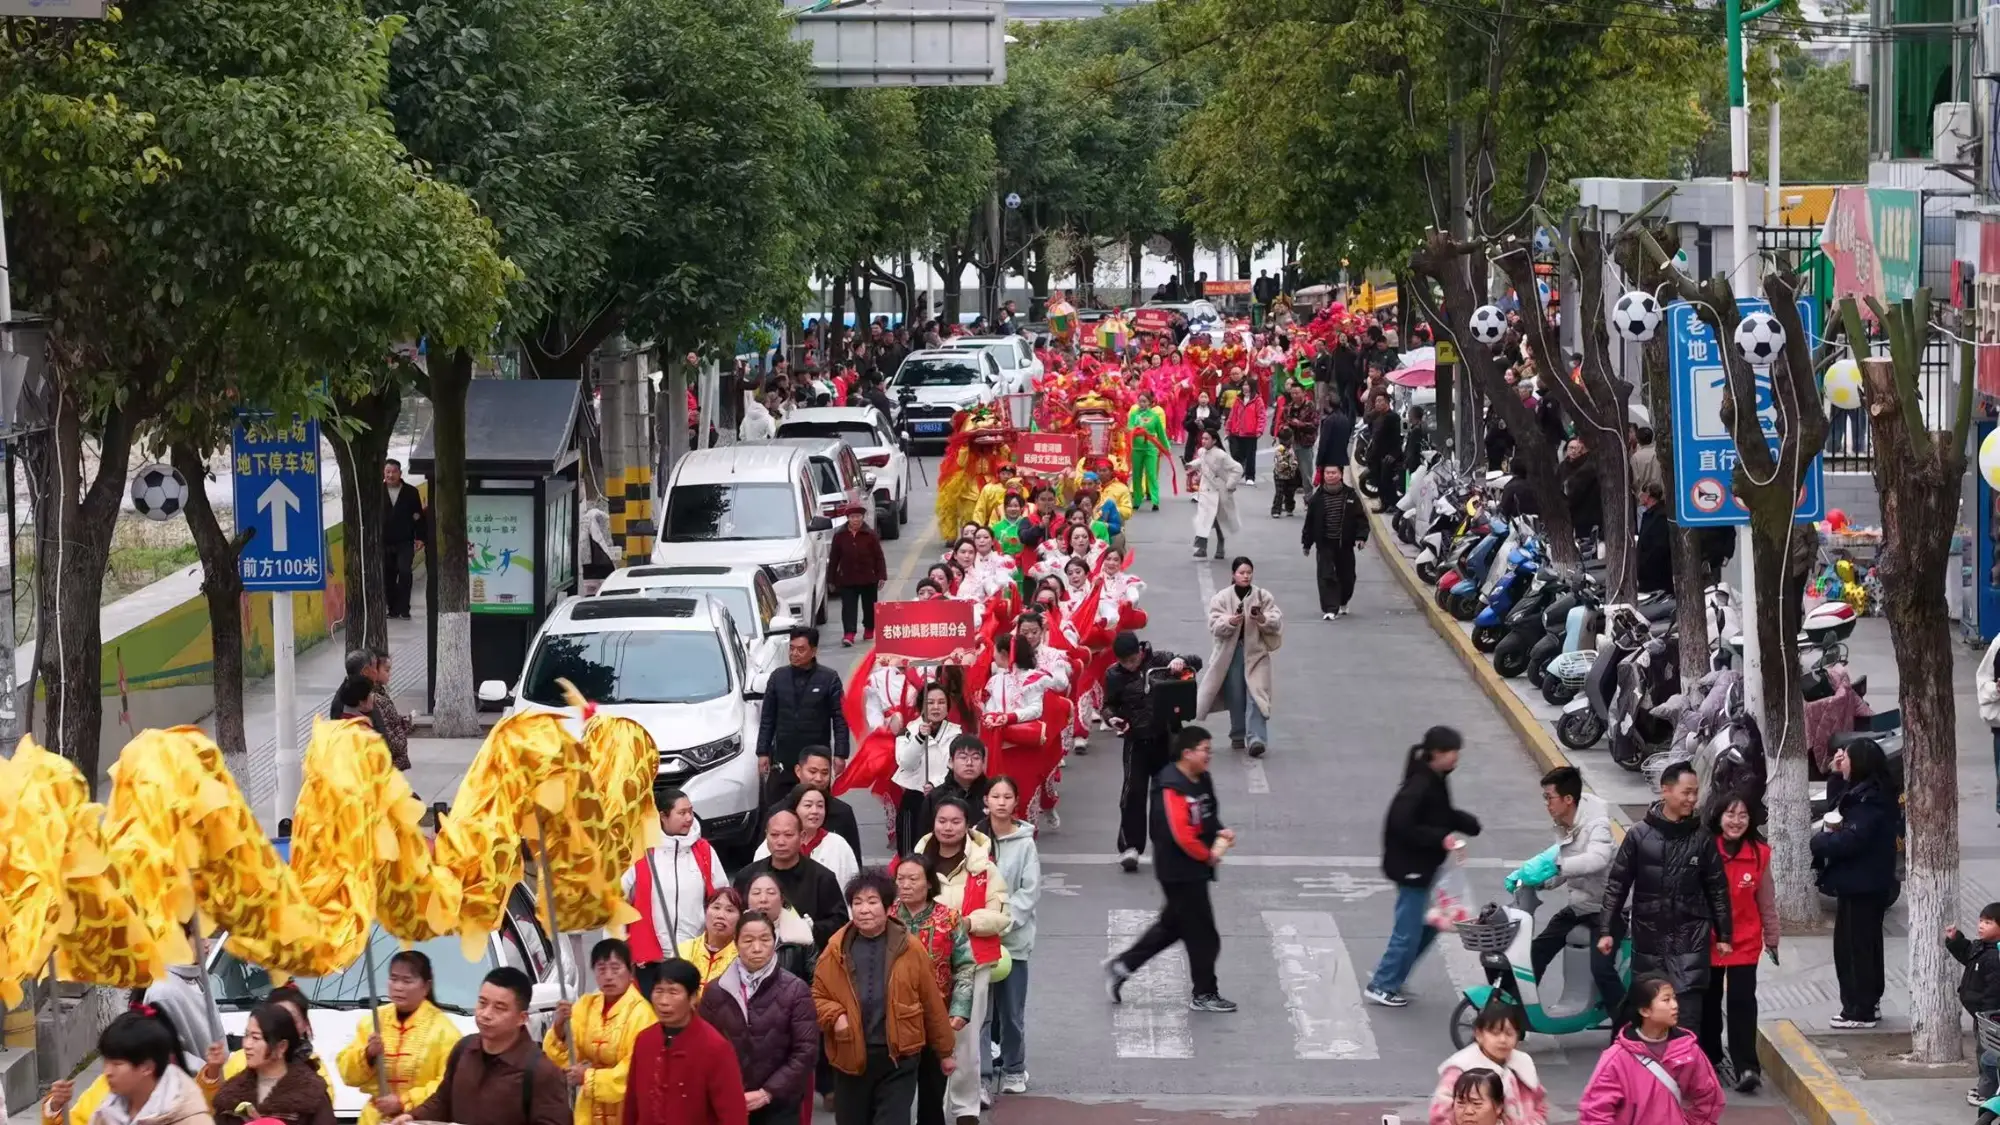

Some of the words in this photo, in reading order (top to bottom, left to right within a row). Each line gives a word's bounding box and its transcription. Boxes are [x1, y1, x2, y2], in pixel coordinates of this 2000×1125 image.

[237, 451, 315, 476] 地下停车场
[243, 556, 318, 578] 前方100米
